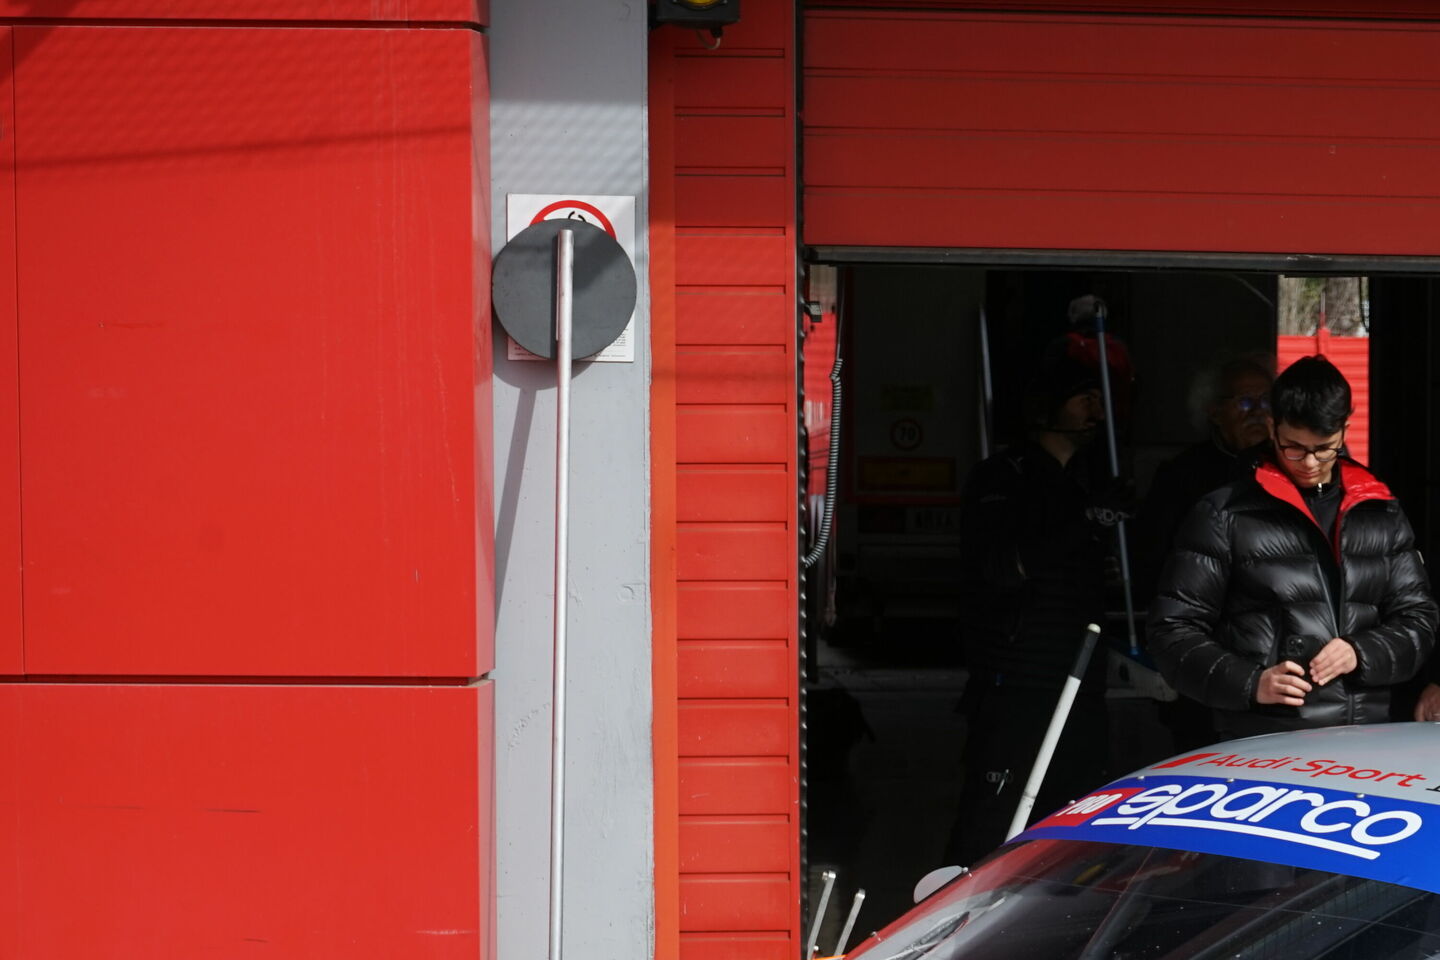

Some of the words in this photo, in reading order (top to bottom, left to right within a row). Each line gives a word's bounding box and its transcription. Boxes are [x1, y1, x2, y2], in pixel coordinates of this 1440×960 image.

[1198, 753, 1302, 770] Audi
[1291, 758, 1427, 787] Sport
[1116, 783, 1422, 845] sparco
